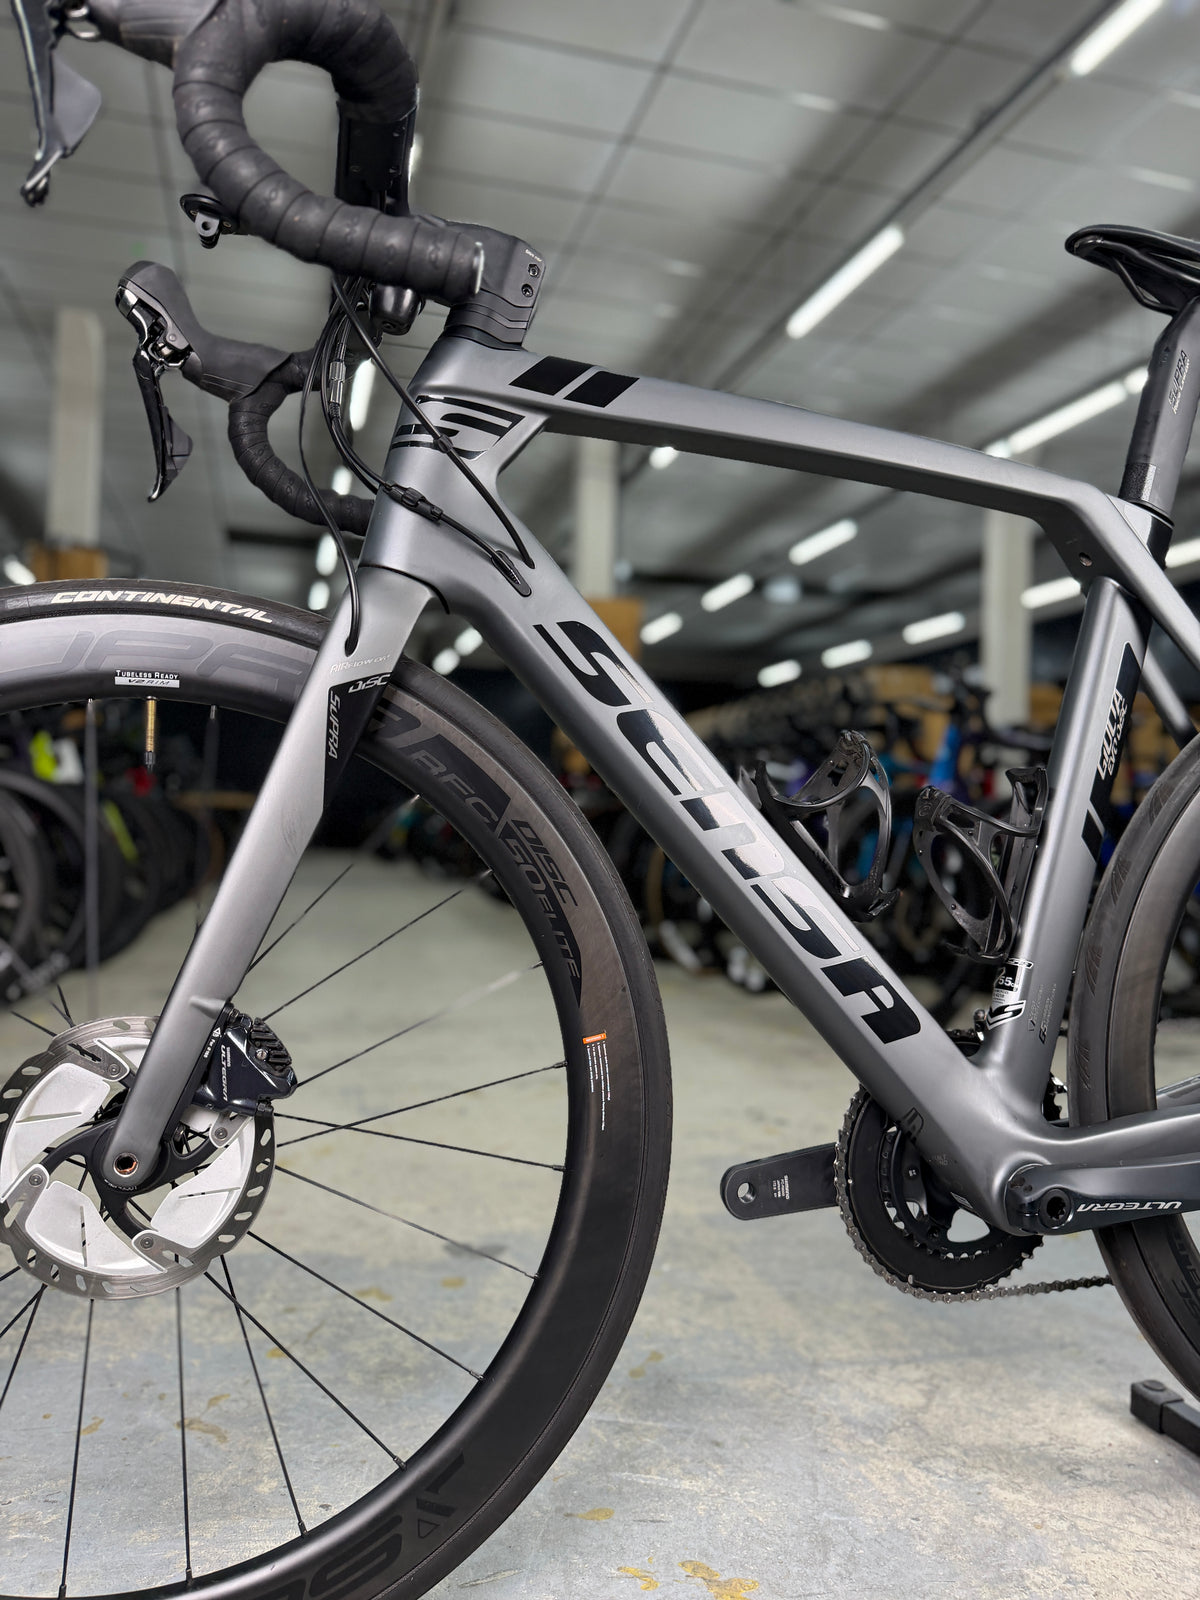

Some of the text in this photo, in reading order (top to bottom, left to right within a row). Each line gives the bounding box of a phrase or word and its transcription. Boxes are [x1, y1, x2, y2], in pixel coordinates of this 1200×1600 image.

[51, 590, 273, 624] CONTINENTAL
[154, 672, 179, 680] READY
[327, 690, 341, 760] SUPRA
[1097, 687, 1123, 781] GIULIA
[511, 819, 579, 907] DISC
[1076, 1201, 1183, 1212] ULTEGRA
